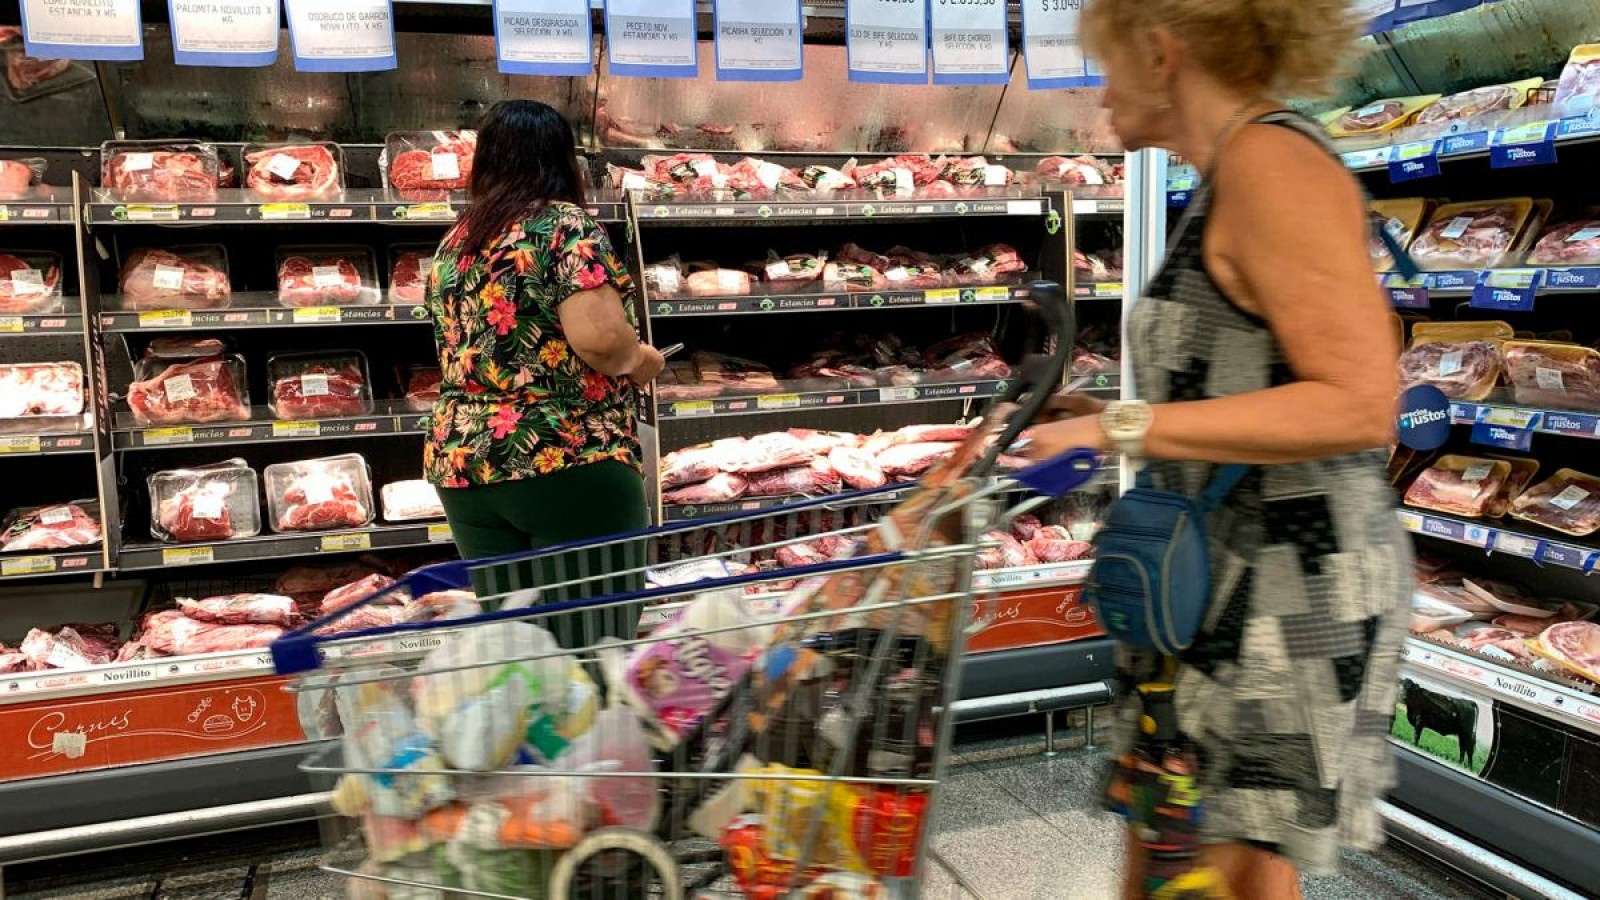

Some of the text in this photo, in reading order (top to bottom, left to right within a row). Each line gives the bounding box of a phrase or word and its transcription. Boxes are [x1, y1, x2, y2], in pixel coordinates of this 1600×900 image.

[48, 7, 117, 17] ESTANCIA X KG
[176, 3, 273, 15] PALOMITA NOVILLITO X
[222, 16, 233, 24] KG
[307, 12, 345, 21] OSOBUCO
[347, 12, 358, 21] DE
[504, 16, 579, 28] PICADA DESGRASADA
[366, 23, 372, 31] X
[374, 23, 384, 31] KG
[626, 22, 652, 32] PECETO
[721, 26, 749, 35] PICANHA
[788, 28, 793, 36] X
[556, 28, 561, 36] X
[563, 29, 573, 37] KG
[623, 31, 661, 40] ESTANCIAS
[850, 30, 862, 38] OJO
[864, 31, 871, 39] DE
[873, 31, 885, 40] BIFE
[943, 34, 991, 42] BIFE DE CHORIZO
[1512, 150, 1536, 161] justos
[675, 207, 712, 215] Estancias
[778, 206, 813, 215] Estancias
[880, 205, 914, 213] Estancias
[973, 203, 1006, 212] Estancias
[1441, 277, 1465, 287] justos
[1555, 274, 1585, 285] justos
[889, 295, 922, 304] Estancias
[1497, 293, 1521, 302] justos
[679, 303, 715, 312] Estancias
[779, 299, 815, 308] Estancias
[340, 310, 381, 318] Estancias
[925, 387, 957, 396] Estancias
[1409, 410, 1446, 429] justos
[1553, 420, 1581, 430] justos
[1494, 431, 1516, 441] justos
[703, 504, 738, 513] Estancias
[1431, 524, 1452, 534] justos
[399, 638, 441, 649] Novillito
[103, 669, 151, 682] Novillito
[1493, 676, 1537, 699] Novillito
